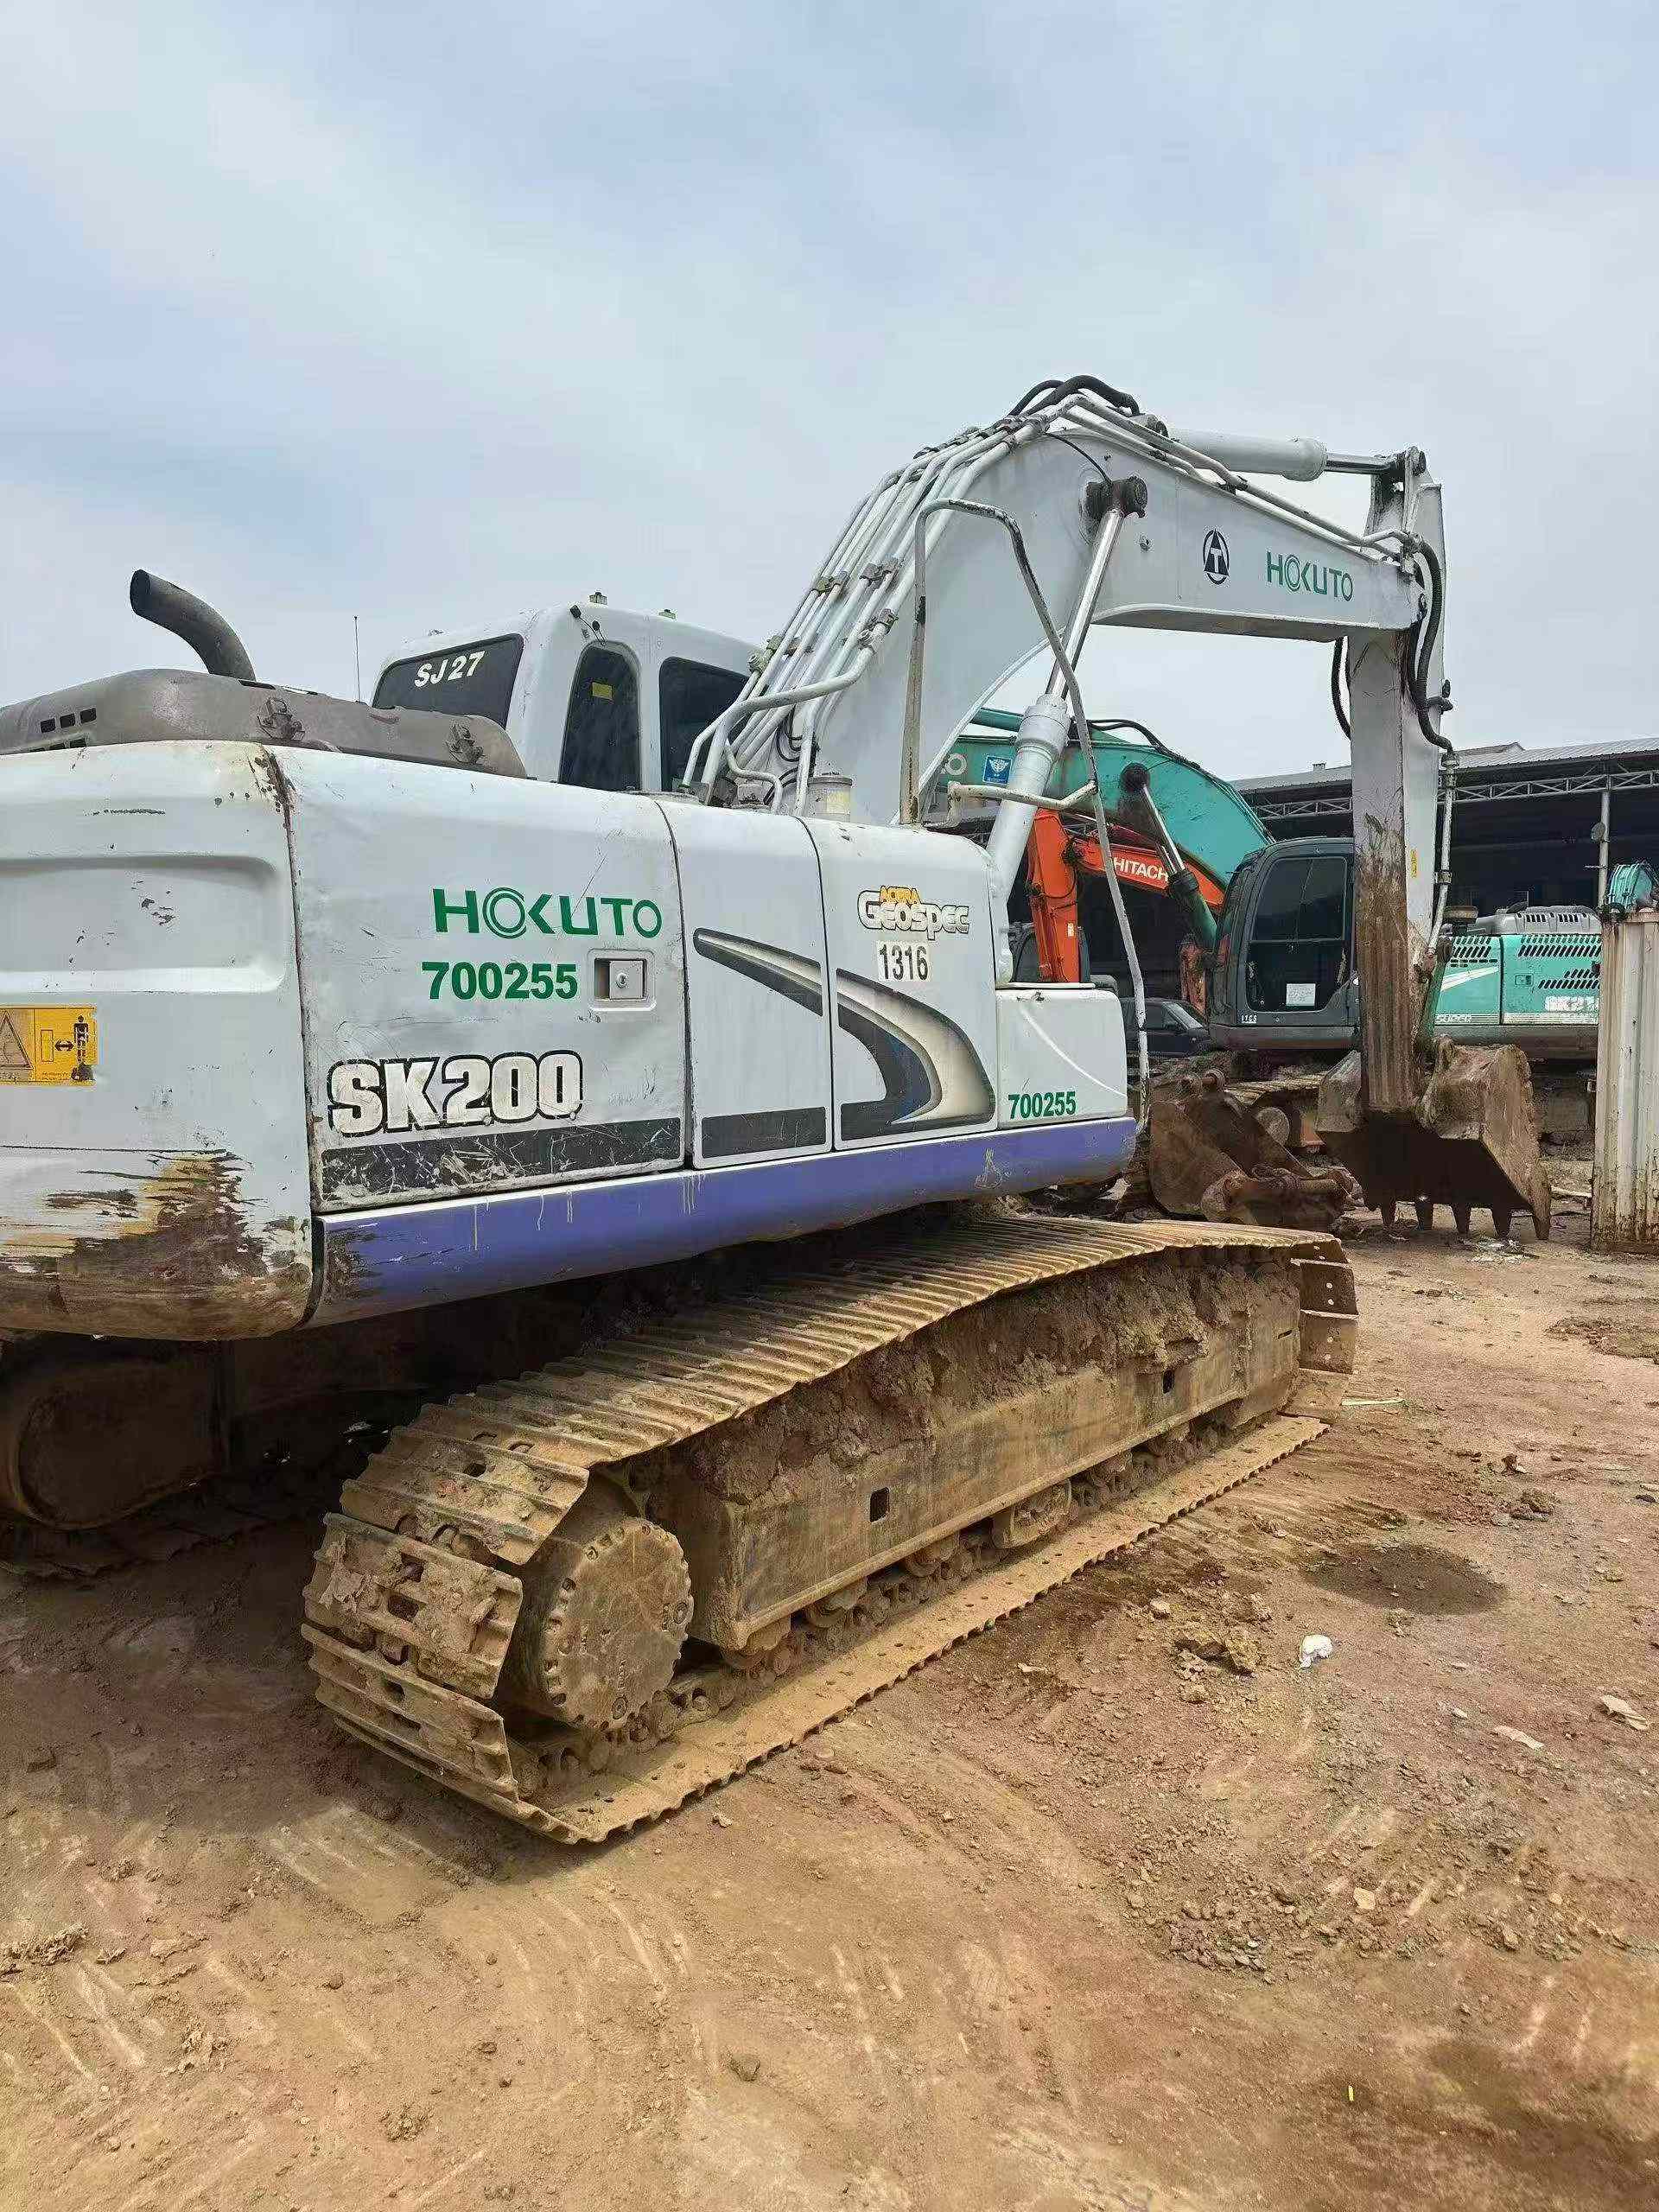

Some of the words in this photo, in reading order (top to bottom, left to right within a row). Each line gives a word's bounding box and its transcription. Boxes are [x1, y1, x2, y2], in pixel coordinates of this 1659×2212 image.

[1267, 551, 1353, 601] HOKUTO
[1114, 856, 1168, 881] HITACH
[432, 887, 663, 938] HOKUTO
[422, 962, 578, 1000] 700255
[880, 944, 929, 981] 1316
[327, 1050, 583, 1137] SK200
[1007, 1091, 1077, 1119] 700255
